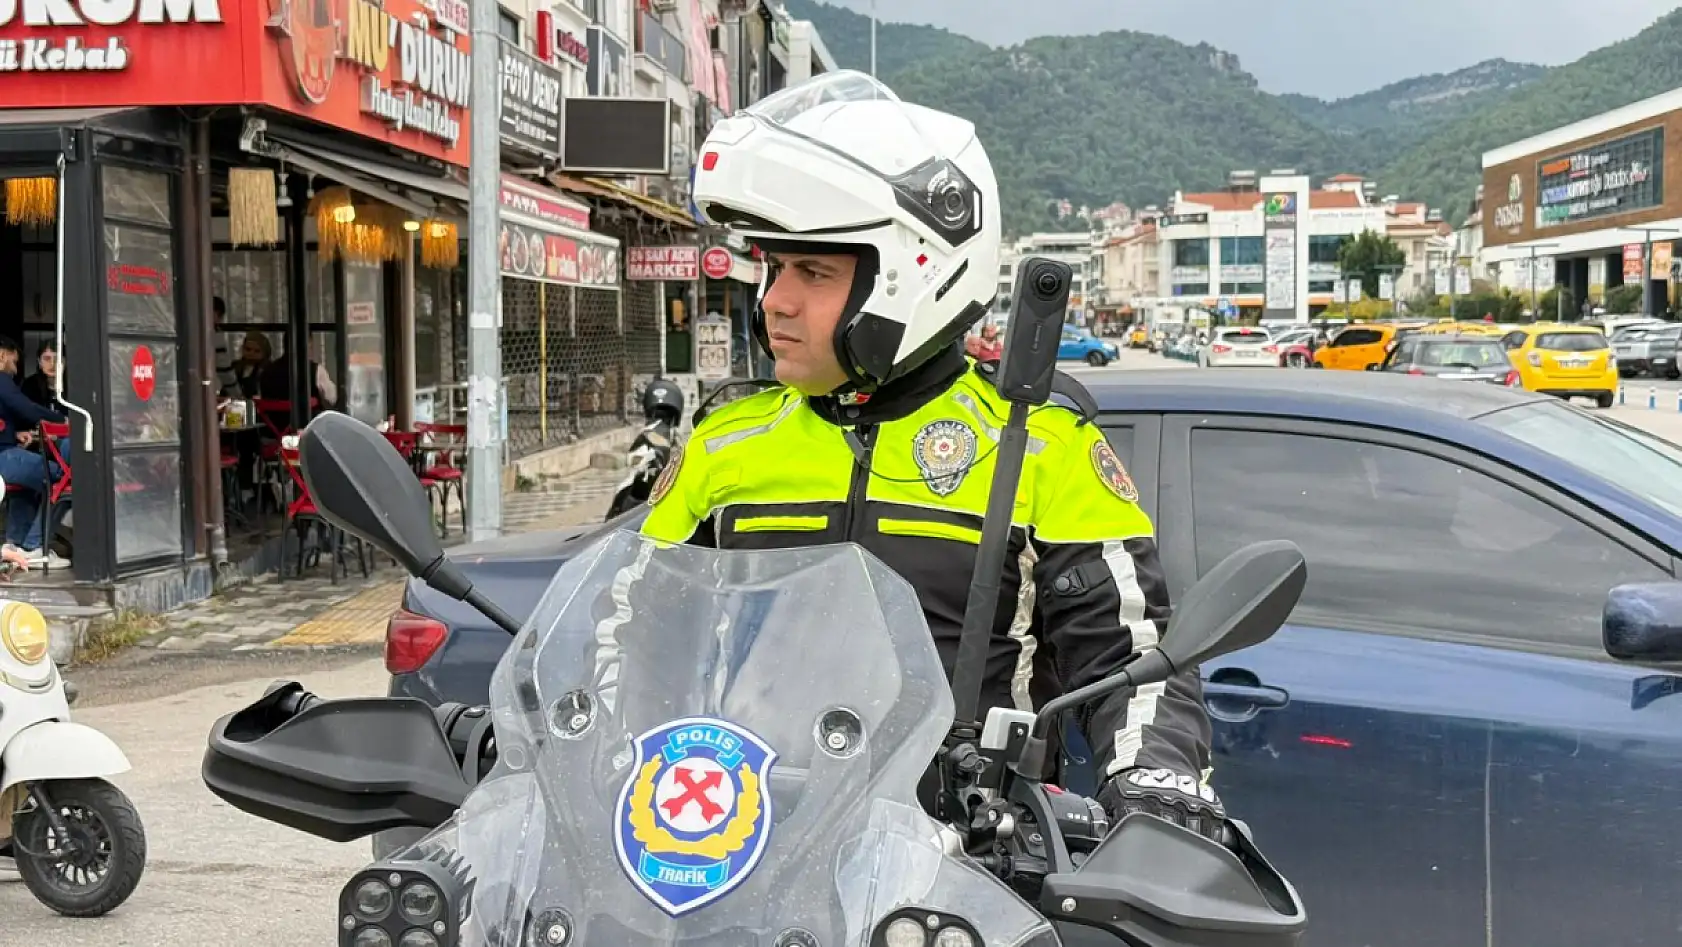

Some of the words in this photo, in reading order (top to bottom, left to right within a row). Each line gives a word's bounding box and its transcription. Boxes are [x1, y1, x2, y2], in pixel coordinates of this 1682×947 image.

[20, 36, 128, 71] Kebab
[503, 54, 530, 101] FOTO
[645, 249, 670, 261] SAAT
[630, 264, 696, 277] MARKET
[676, 729, 735, 751] POLİS
[658, 865, 708, 883] TRAFİK
